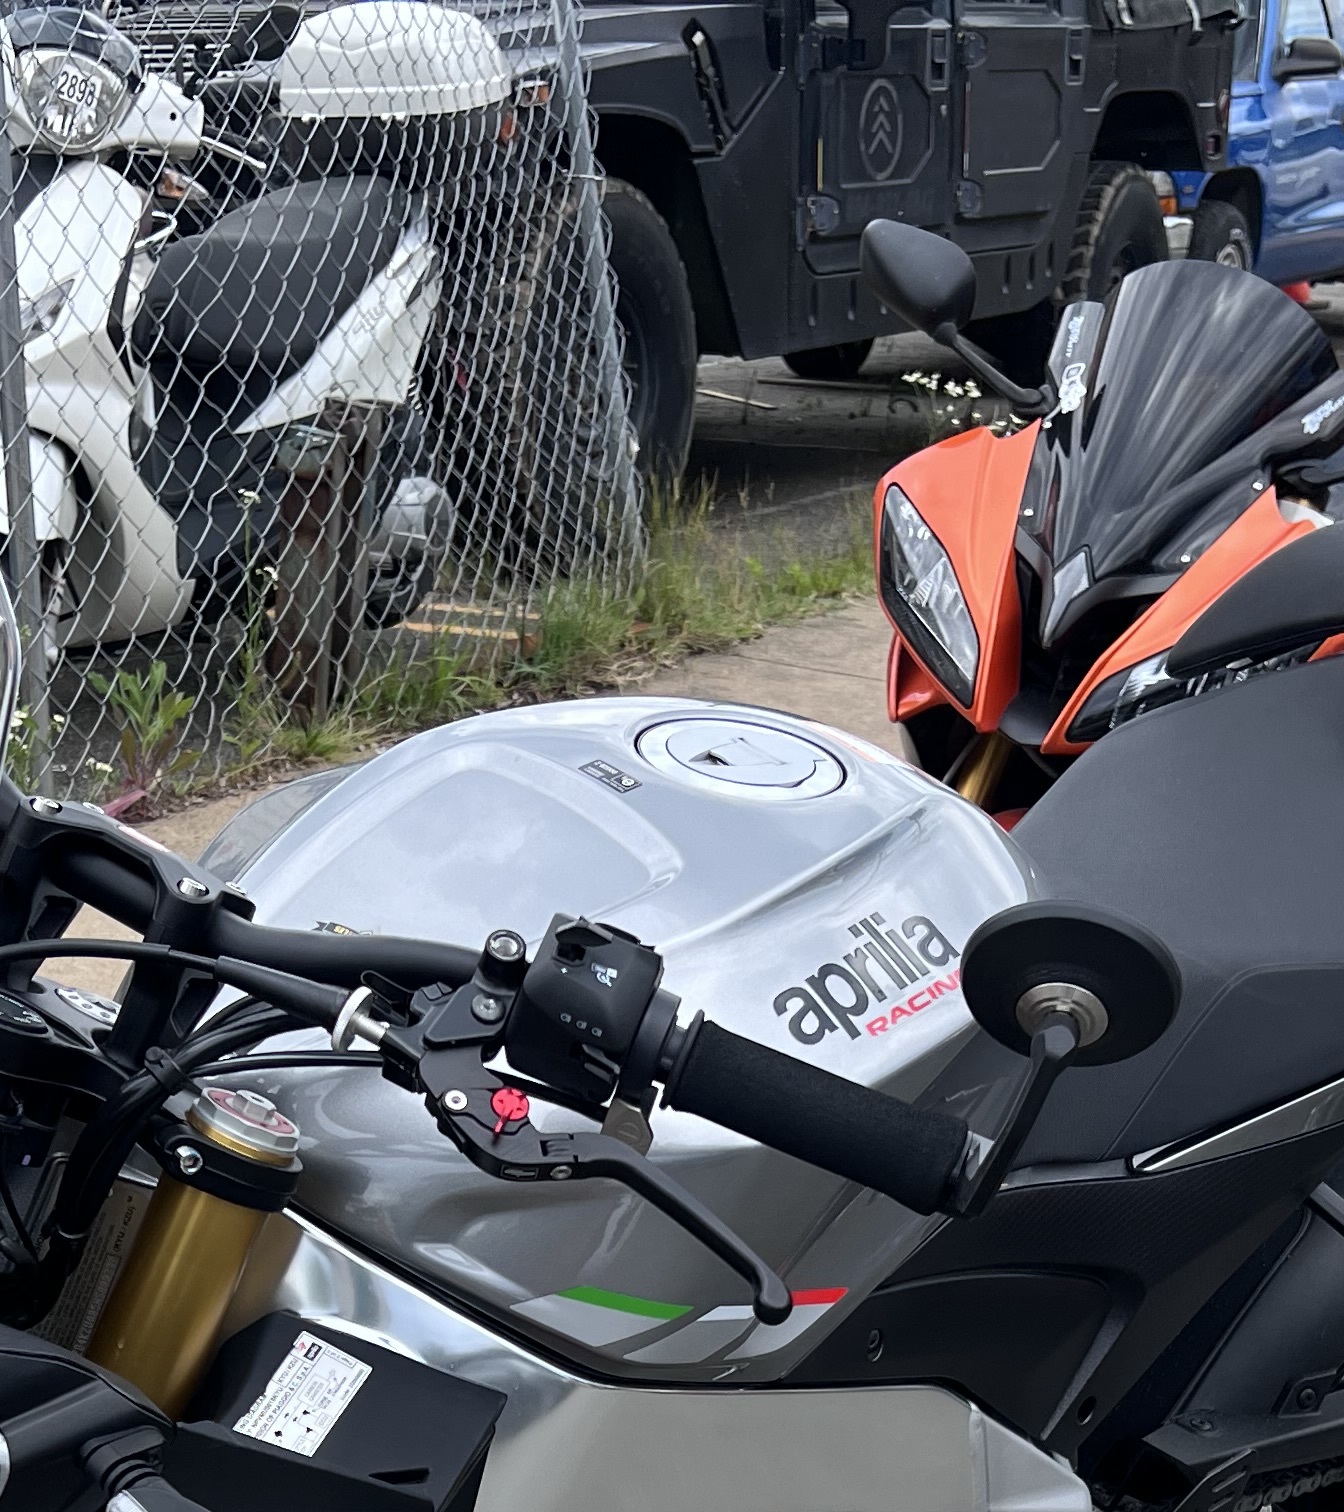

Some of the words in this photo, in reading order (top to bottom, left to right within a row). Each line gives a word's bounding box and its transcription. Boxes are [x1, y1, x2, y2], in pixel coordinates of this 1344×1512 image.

[57, 71, 96, 107] 2898
[773, 911, 961, 1046] aprilia
[865, 968, 961, 1037] RACIN
